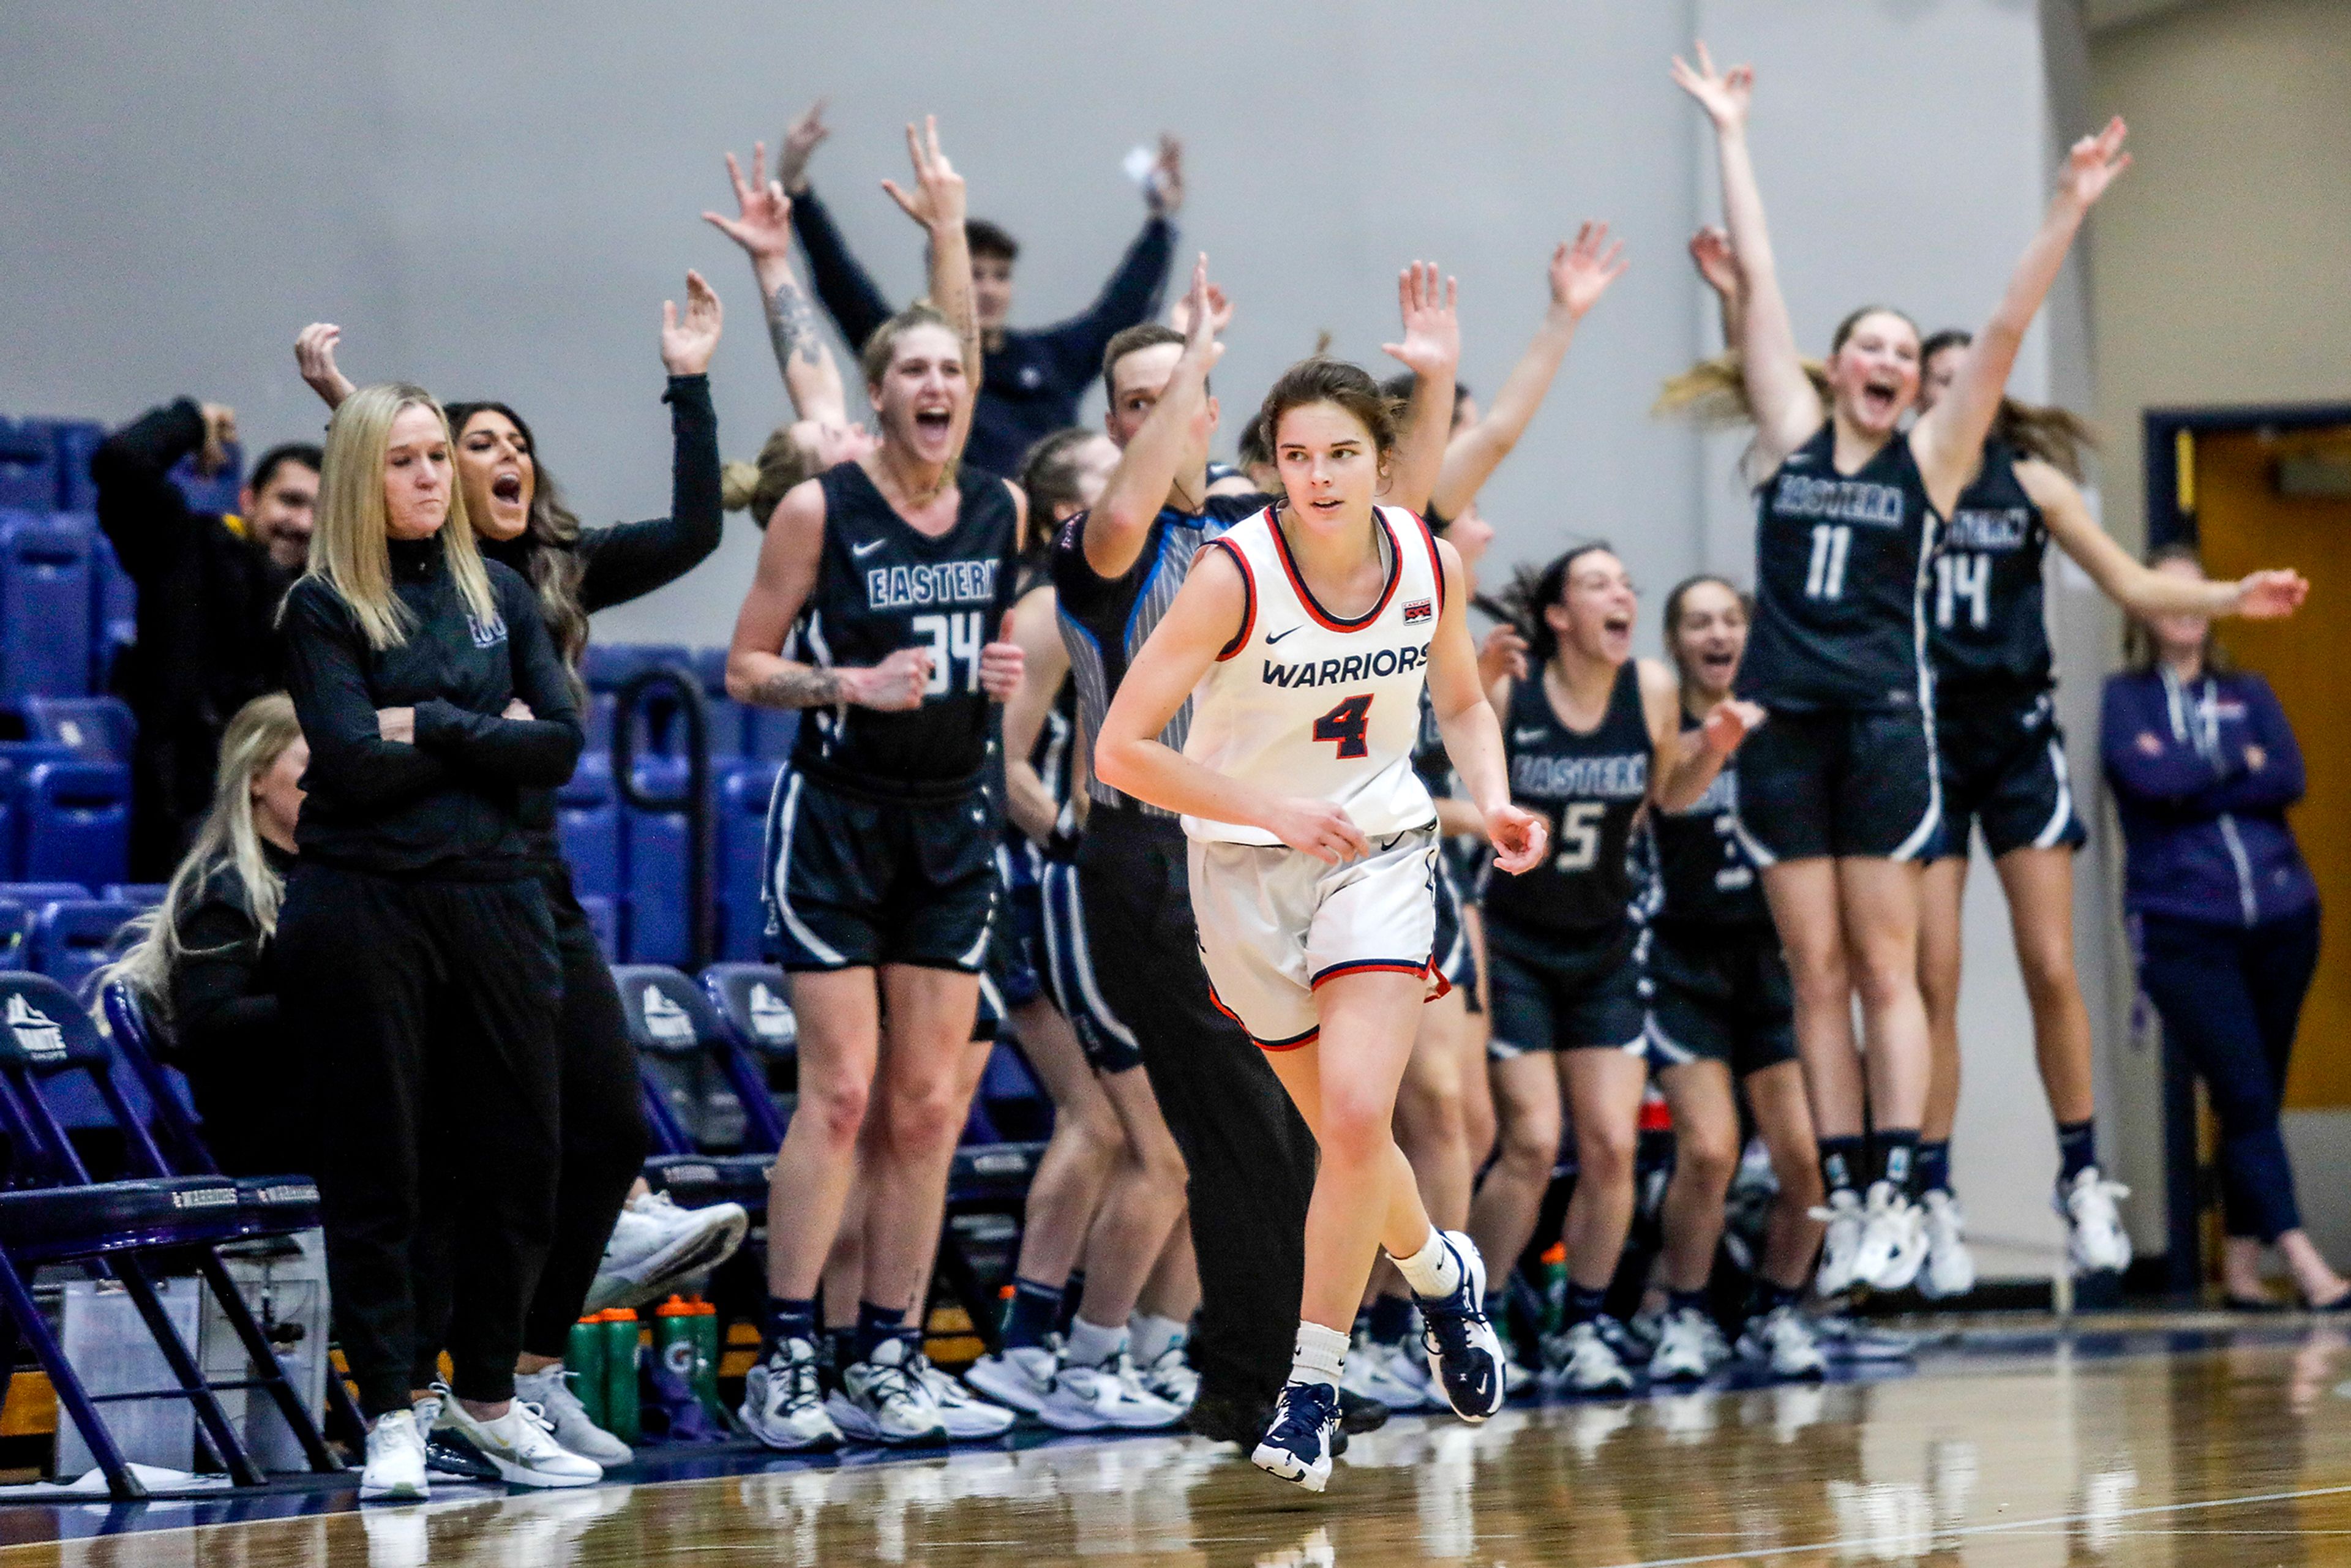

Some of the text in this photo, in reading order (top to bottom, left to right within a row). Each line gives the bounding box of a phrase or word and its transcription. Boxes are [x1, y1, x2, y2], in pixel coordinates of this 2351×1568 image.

[1806, 523, 1853, 599] 11
[1936, 552, 1991, 628] 14
[912, 611, 981, 694] 34
[1262, 641, 1431, 688] WARRIORS
[1313, 693, 1374, 759] 4
[1556, 801, 1605, 872] 5
